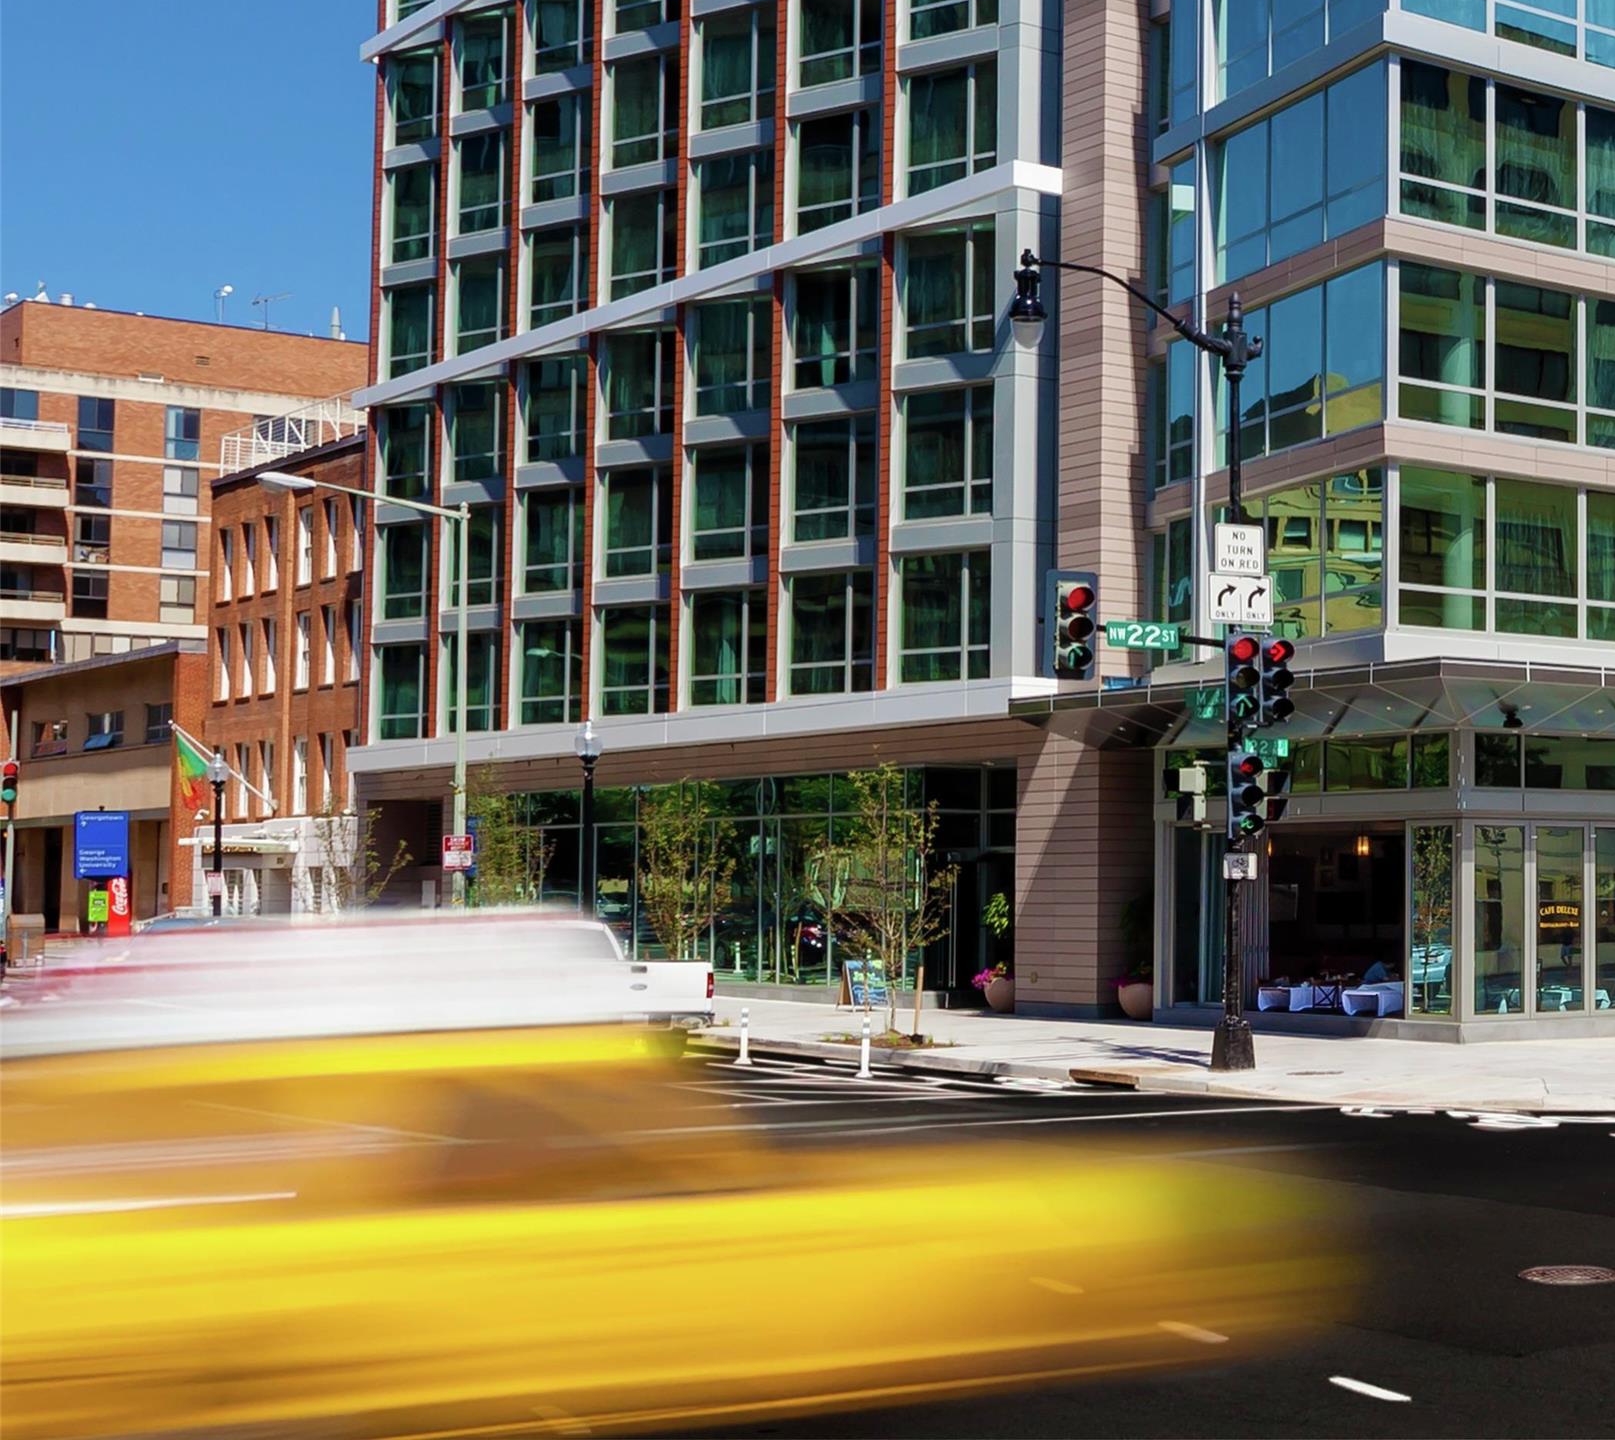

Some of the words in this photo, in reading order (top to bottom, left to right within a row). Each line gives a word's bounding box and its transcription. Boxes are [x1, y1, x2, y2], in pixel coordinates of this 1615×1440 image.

[1232, 531, 1246, 541] NO
[1227, 545, 1253, 556] TURN
[1220, 558, 1235, 568] ON
[1239, 559, 1259, 569] RED
[1215, 610, 1235, 618] ONLY
[1246, 611, 1266, 619] ONLY
[1109, 626, 1126, 640] NW
[1127, 624, 1161, 647] 22
[1162, 629, 1175, 643] ST
